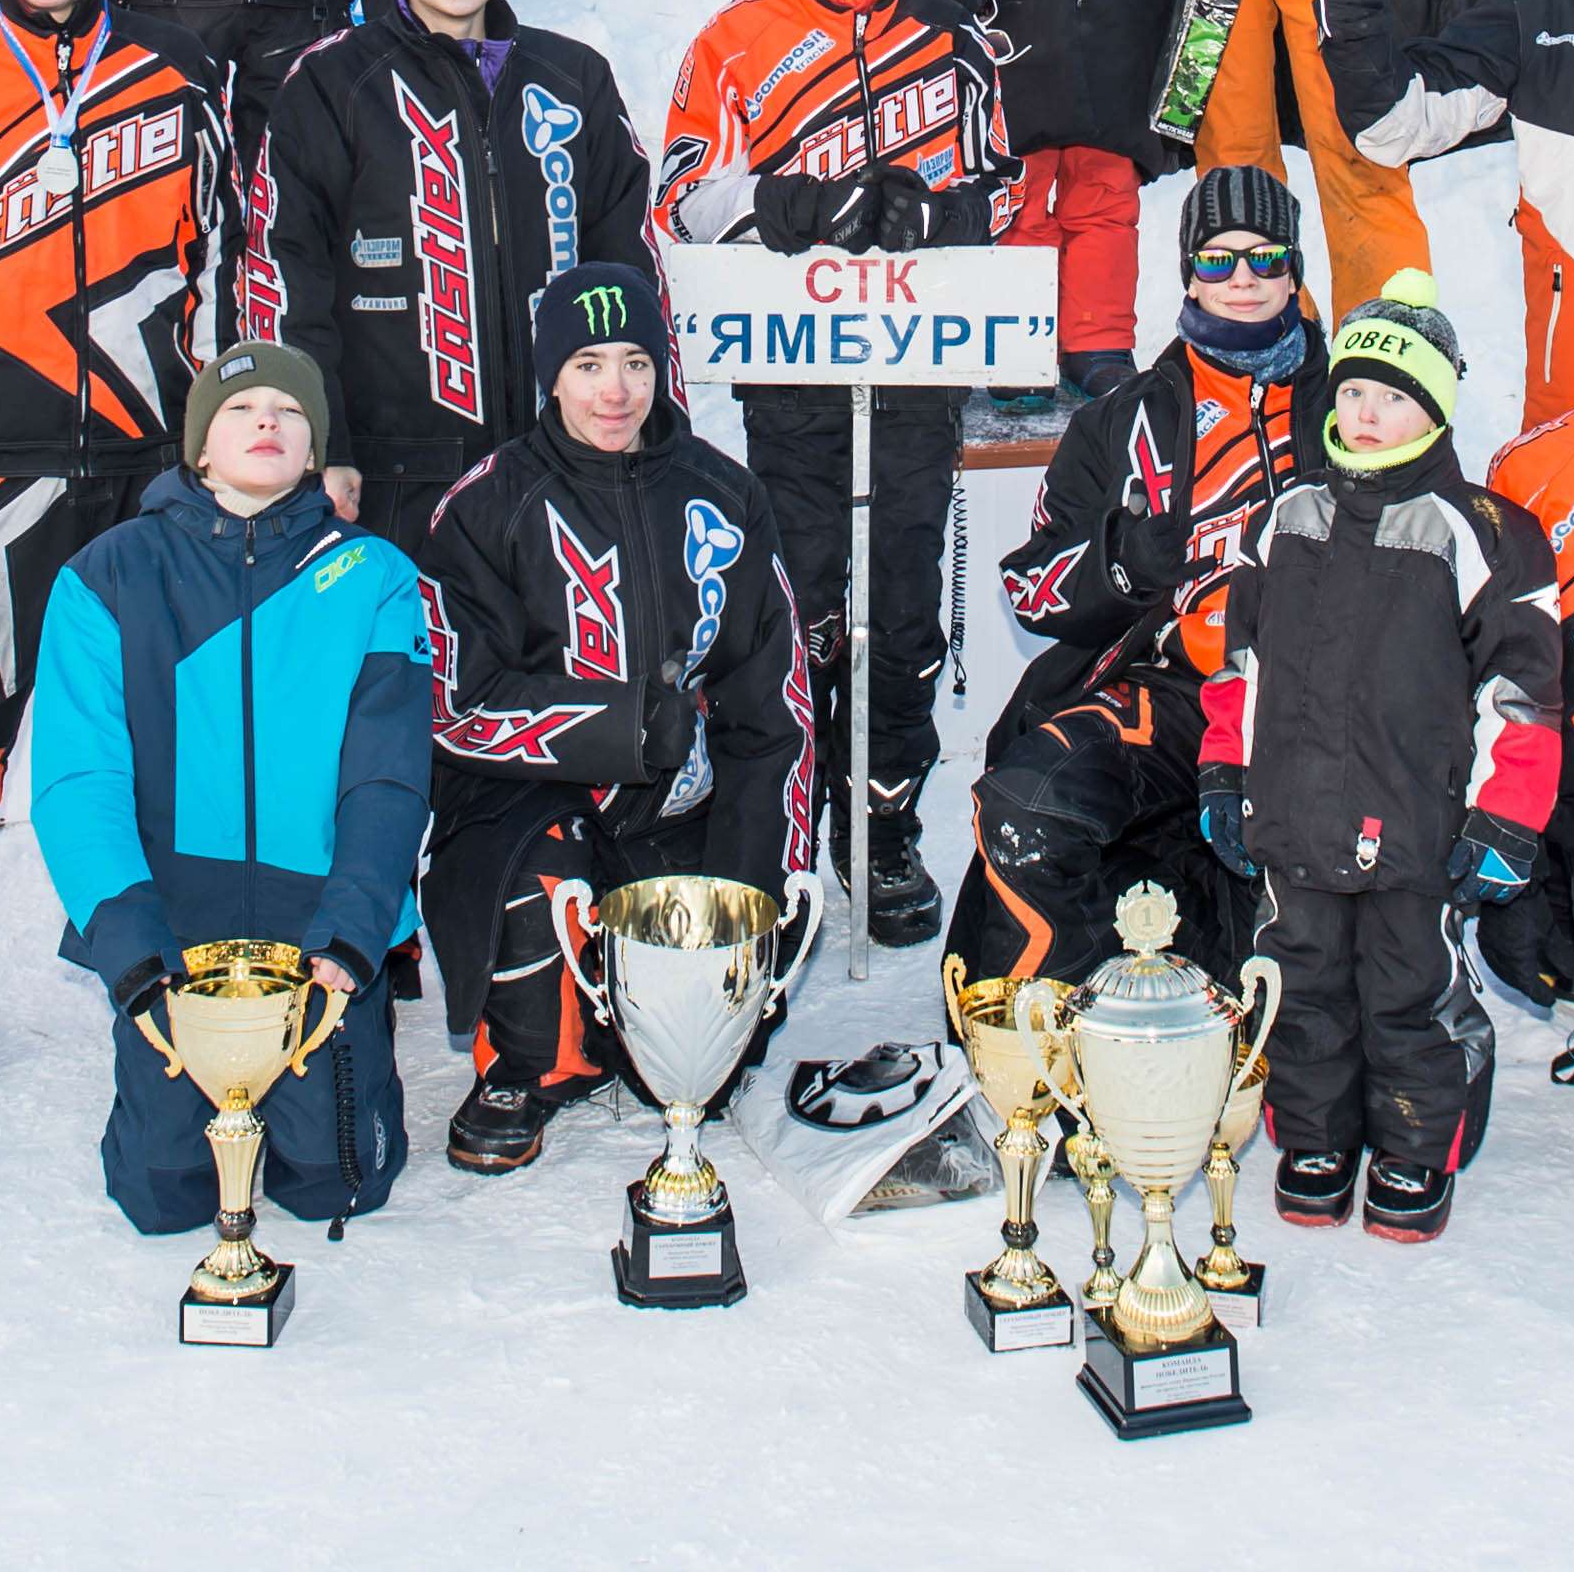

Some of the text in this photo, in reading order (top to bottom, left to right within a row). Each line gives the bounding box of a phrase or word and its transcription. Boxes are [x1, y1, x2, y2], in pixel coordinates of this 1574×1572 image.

[754, 28, 828, 104] composit
[793, 39, 835, 72] tracks
[805, 257, 918, 305] СТК
[1344, 331, 1415, 357] OBEY
